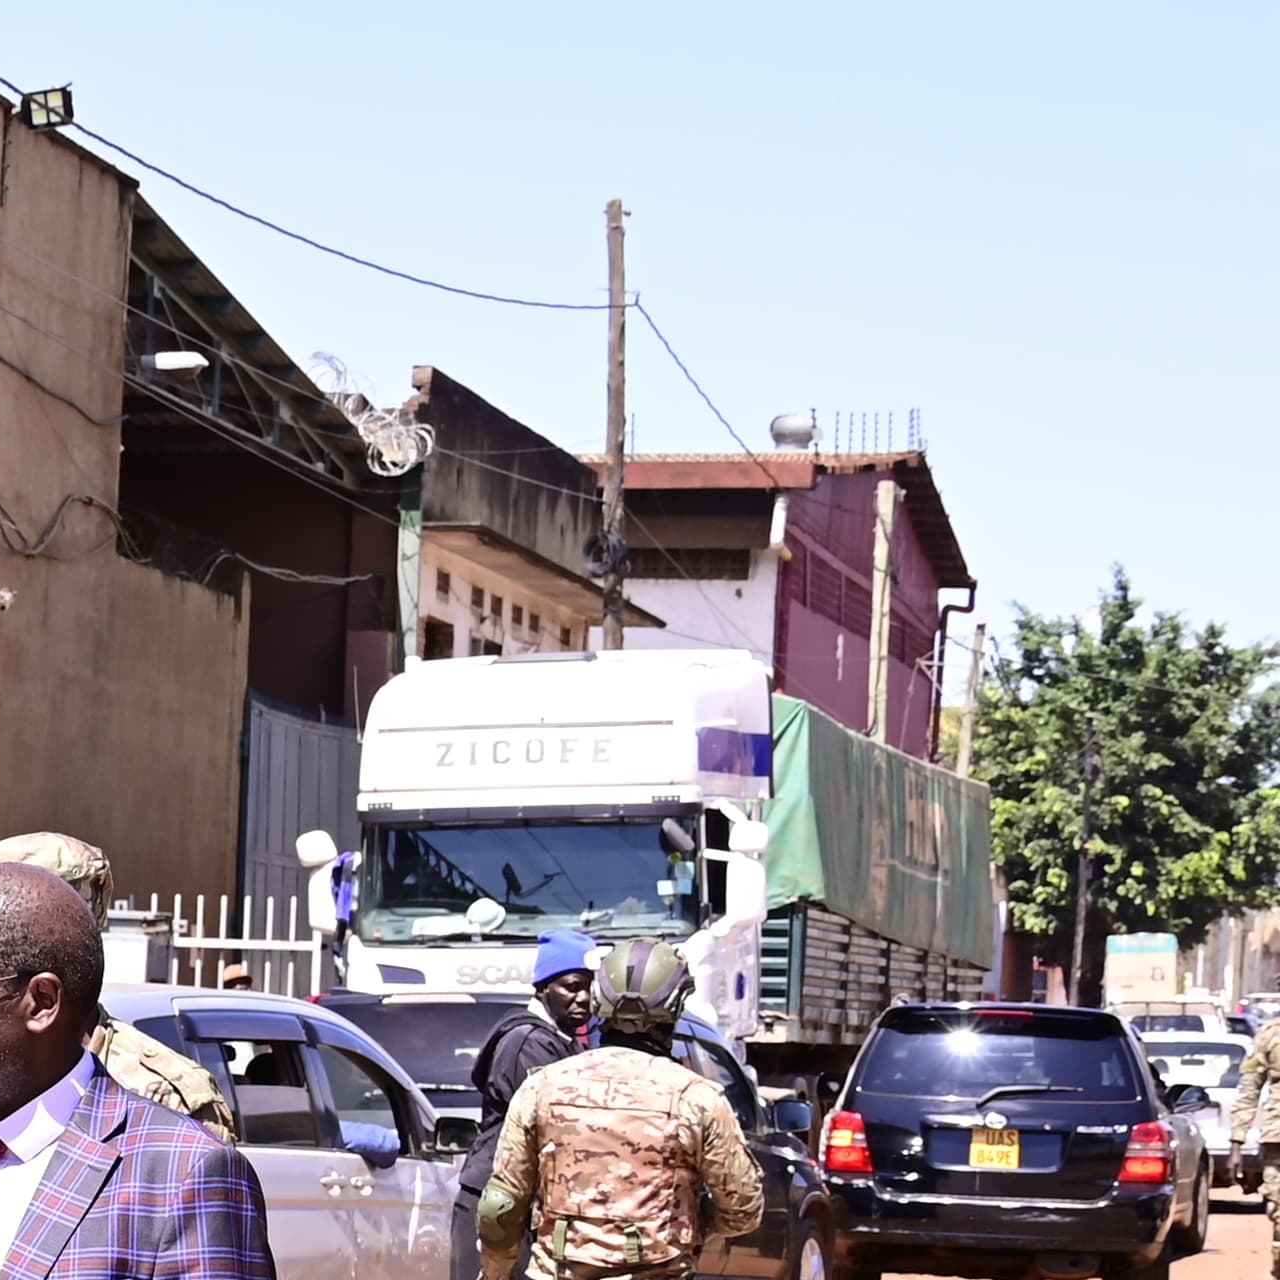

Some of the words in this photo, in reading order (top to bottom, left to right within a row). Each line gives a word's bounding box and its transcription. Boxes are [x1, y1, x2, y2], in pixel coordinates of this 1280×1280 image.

[435, 738, 611, 767] ZICOFE
[456, 964, 533, 985] SCA
[986, 1131, 1016, 1147] UAS
